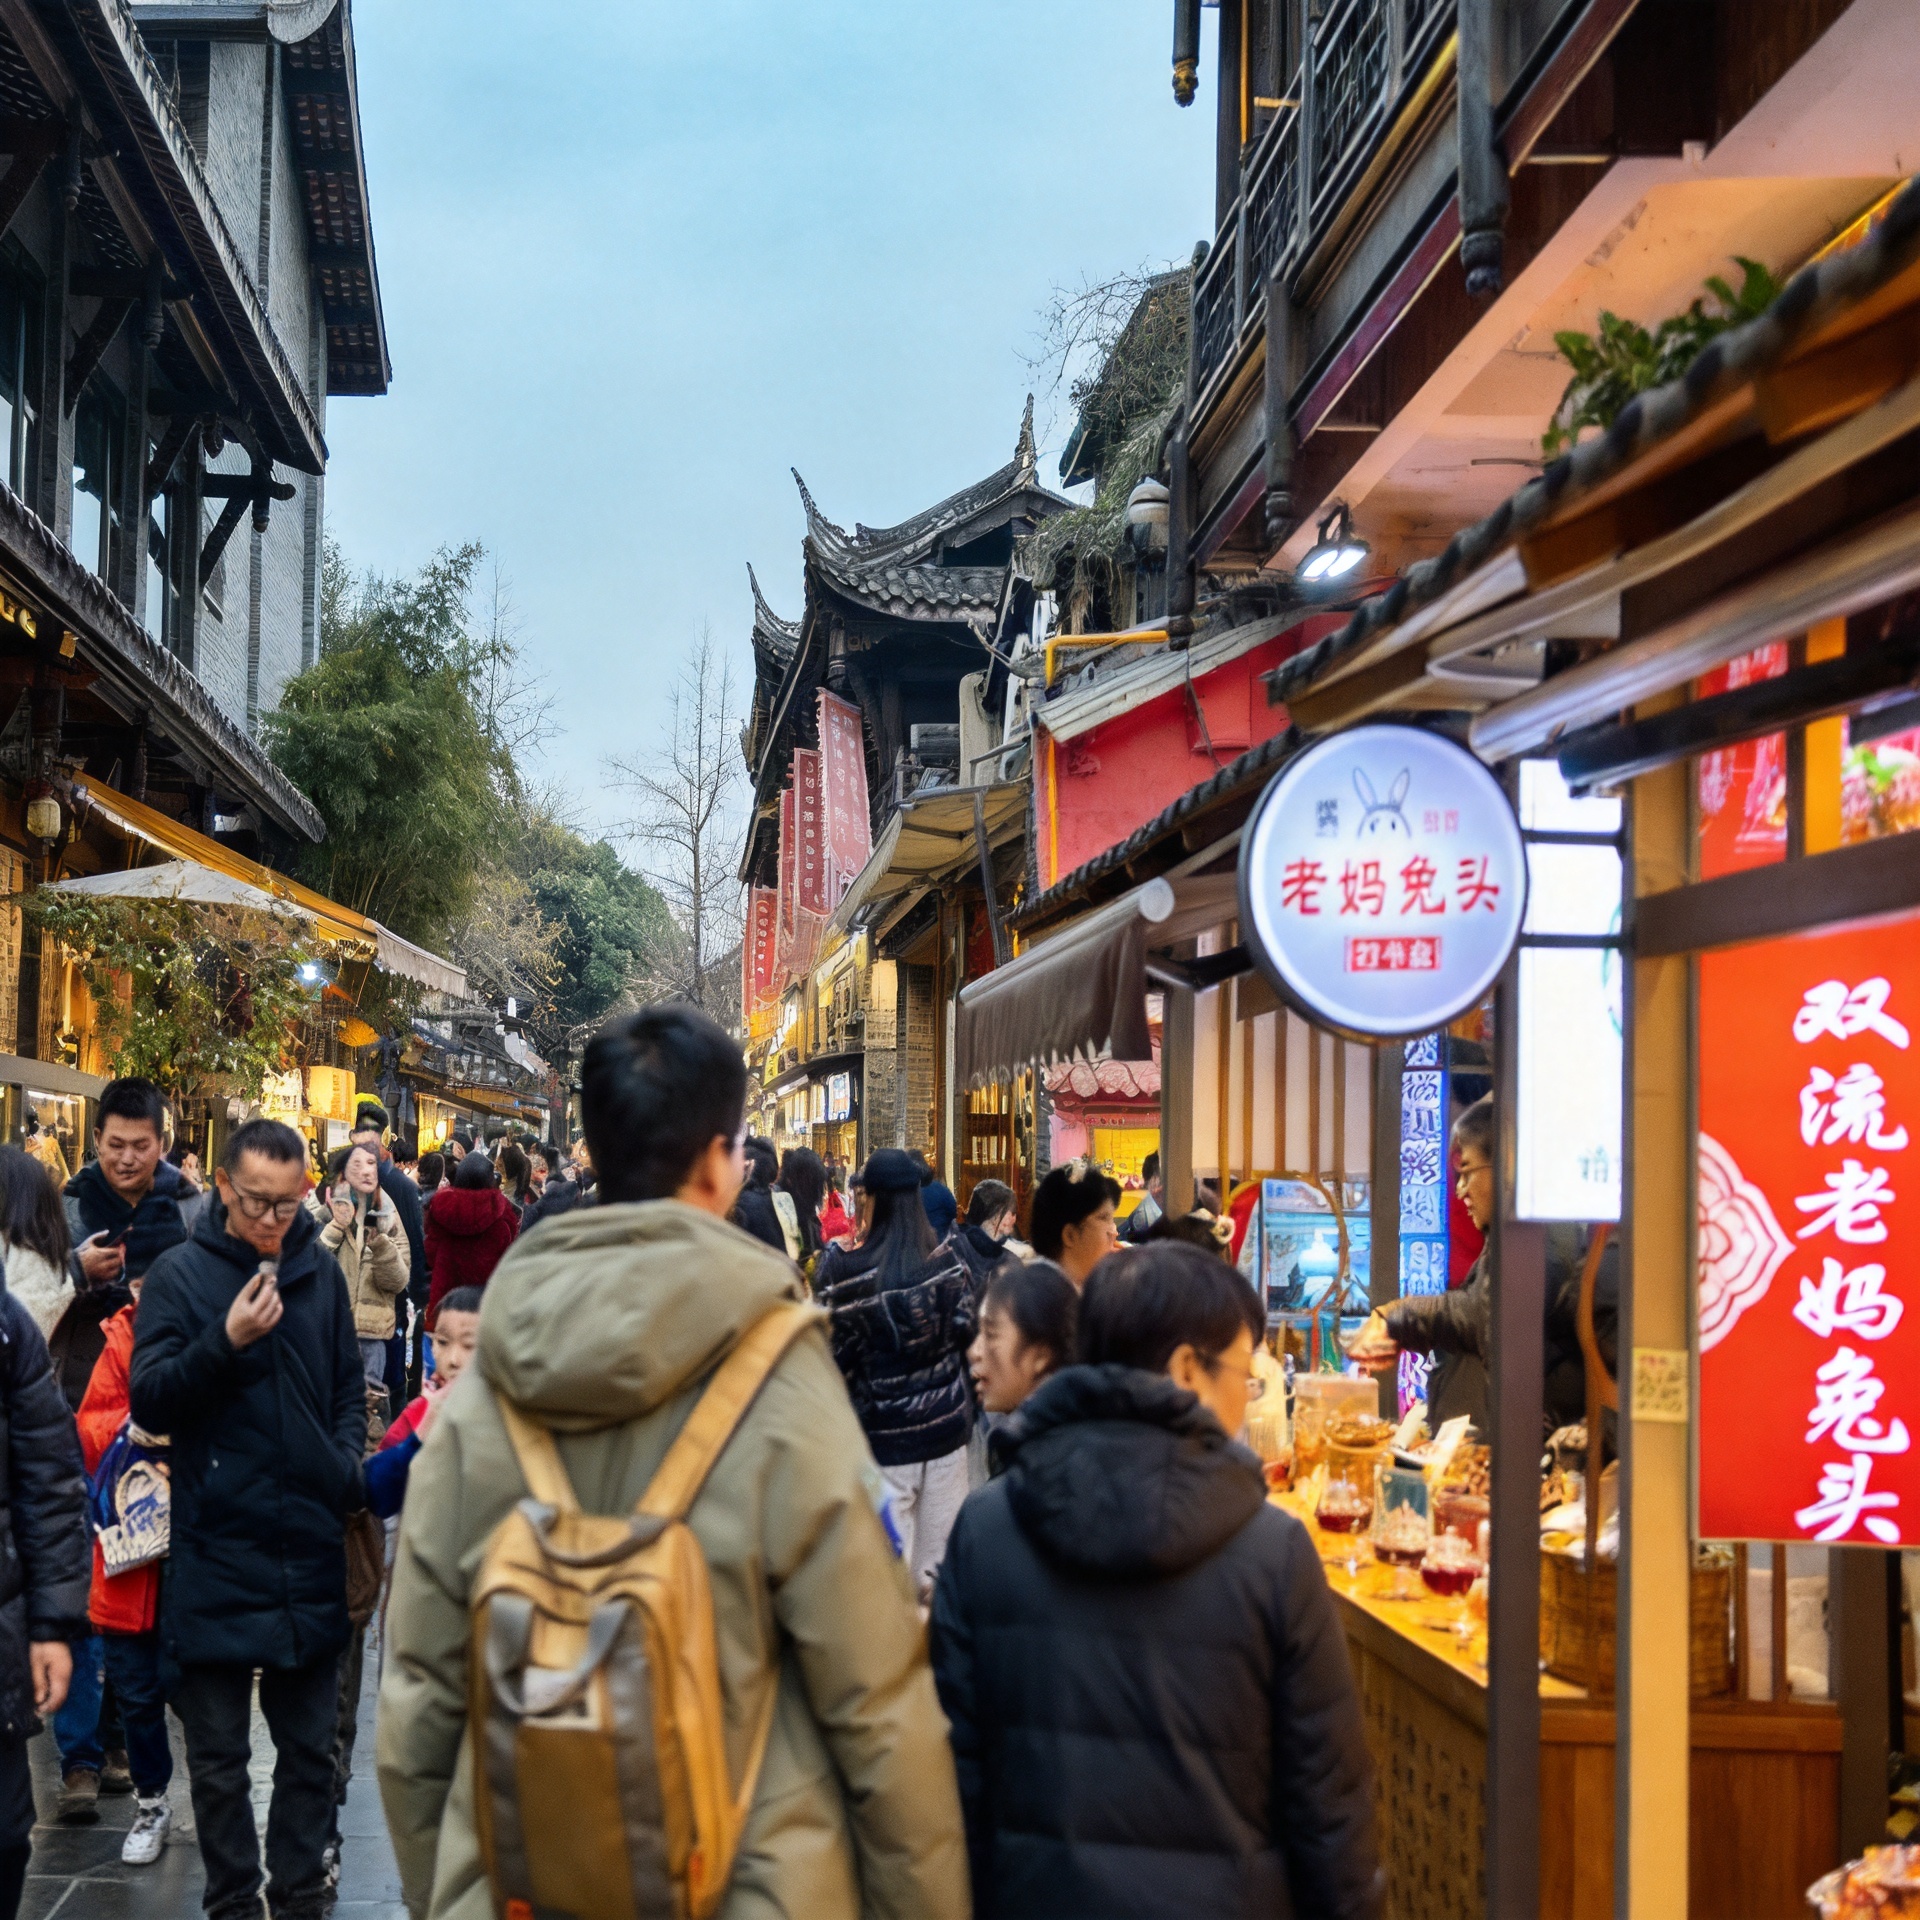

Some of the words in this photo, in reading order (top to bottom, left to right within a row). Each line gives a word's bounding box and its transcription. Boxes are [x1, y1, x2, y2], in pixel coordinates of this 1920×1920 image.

[1792, 976, 1911, 1543] 双流老妈兔头
